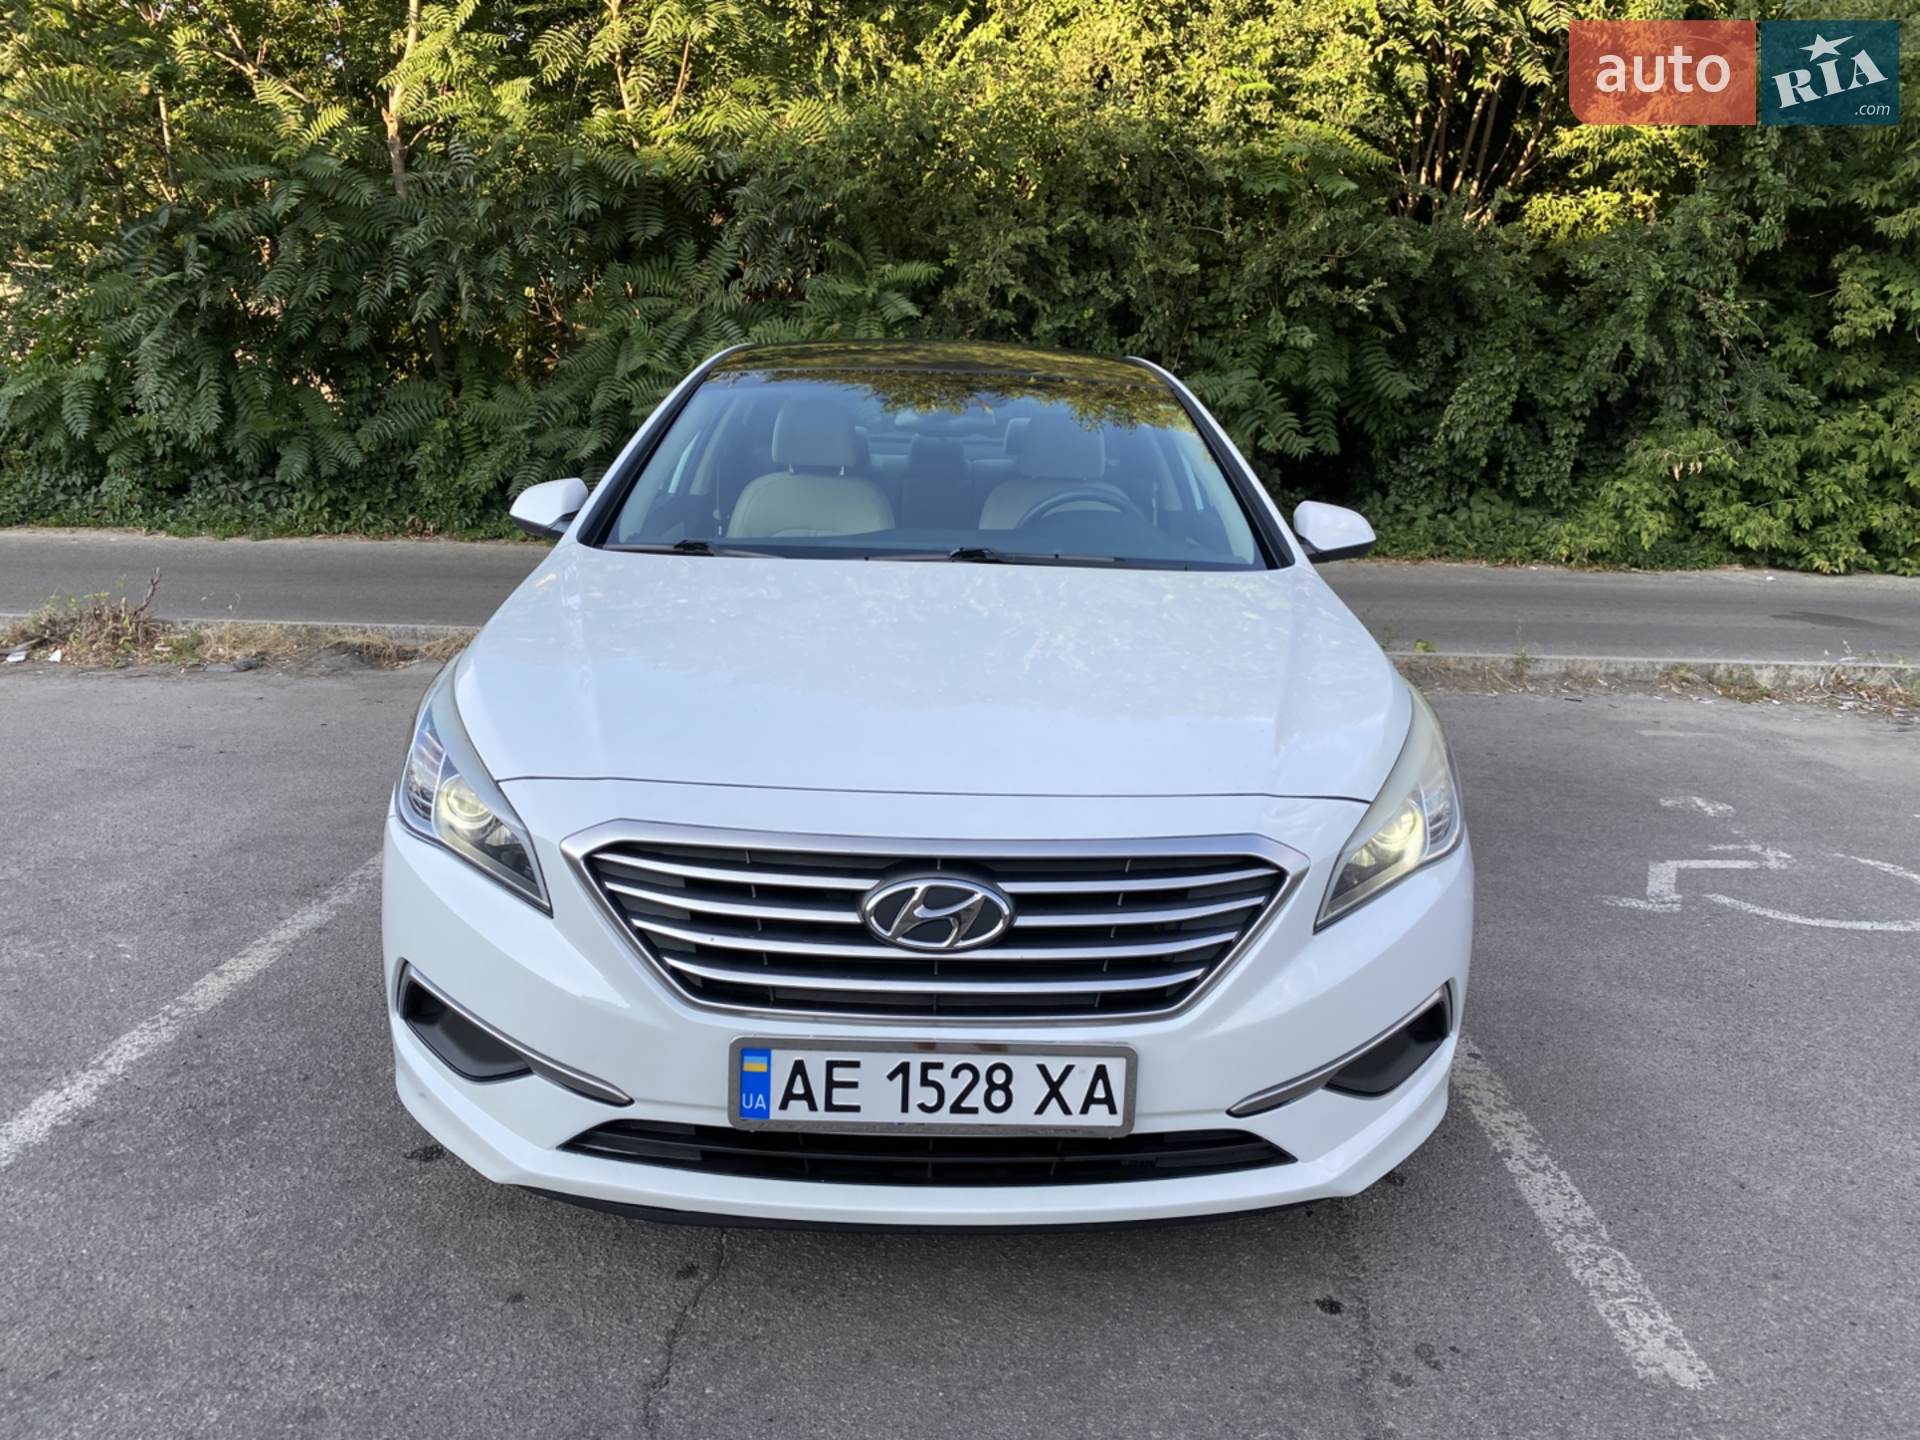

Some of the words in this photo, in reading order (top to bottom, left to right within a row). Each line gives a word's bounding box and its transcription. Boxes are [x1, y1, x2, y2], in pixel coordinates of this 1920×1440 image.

[741, 1092, 767, 1111] UA
[778, 1059, 862, 1113] AE
[886, 1061, 1014, 1114] 1528
[1033, 1063, 1119, 1116] XA
